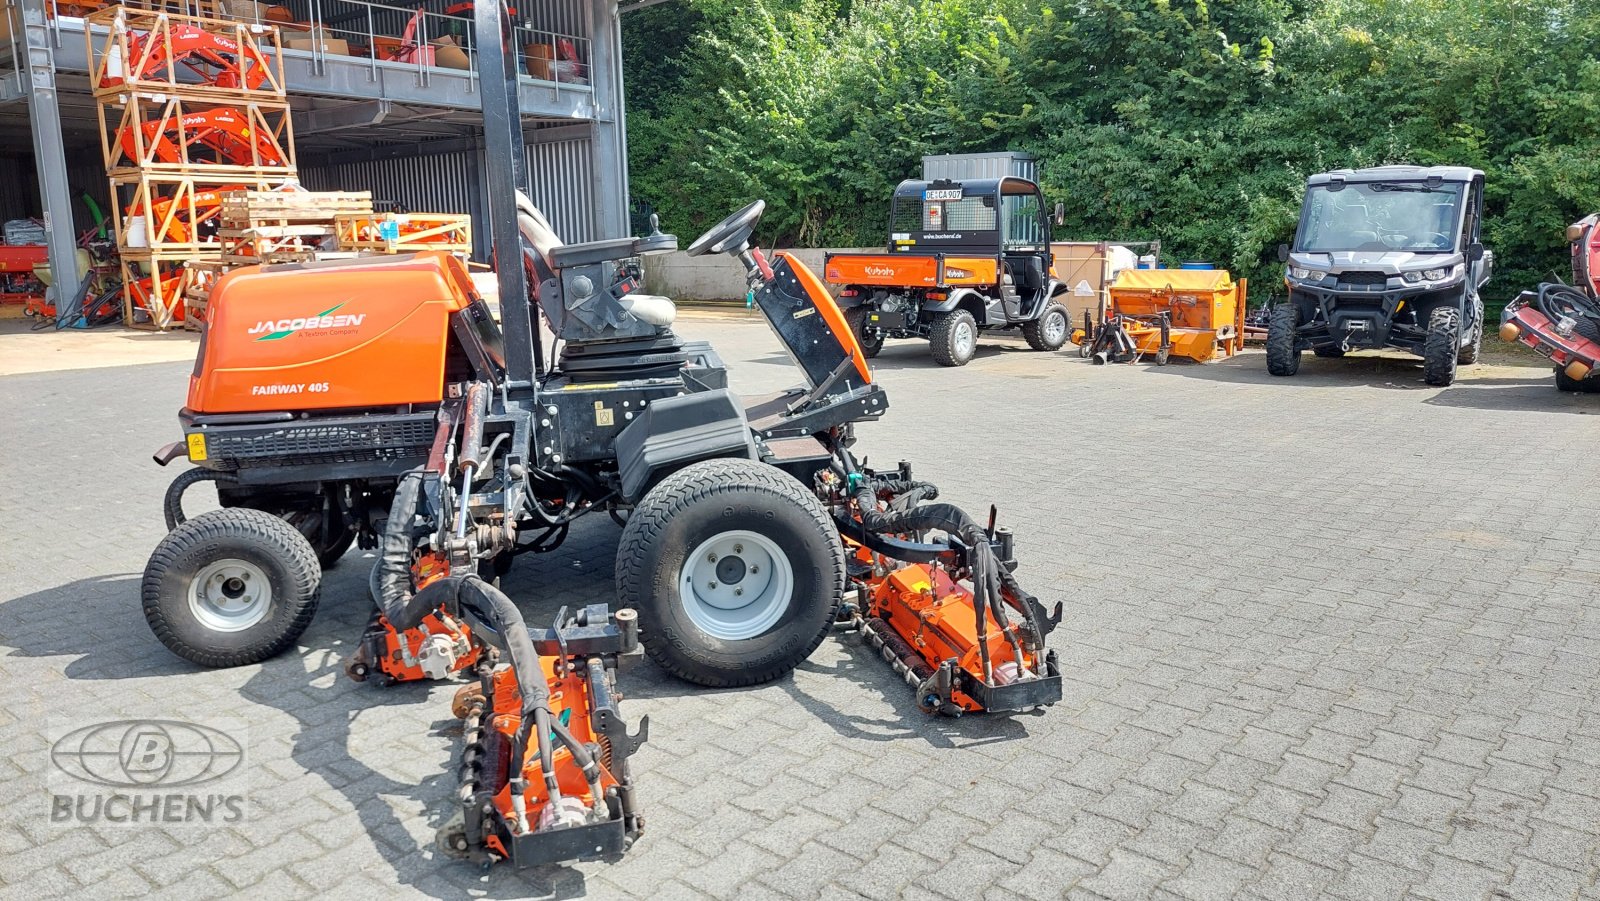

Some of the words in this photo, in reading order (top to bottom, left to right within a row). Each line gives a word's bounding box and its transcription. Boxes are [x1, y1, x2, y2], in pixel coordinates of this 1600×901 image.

[181, 116, 207, 125] ubota
[948, 190, 960, 198] 907
[864, 266, 895, 276] Kubota
[946, 269, 965, 278] Kubota
[248, 314, 366, 334] JACOBSEN
[330, 329, 358, 338] Company
[252, 383, 305, 396] FAIRWAY
[308, 382, 330, 394] 405
